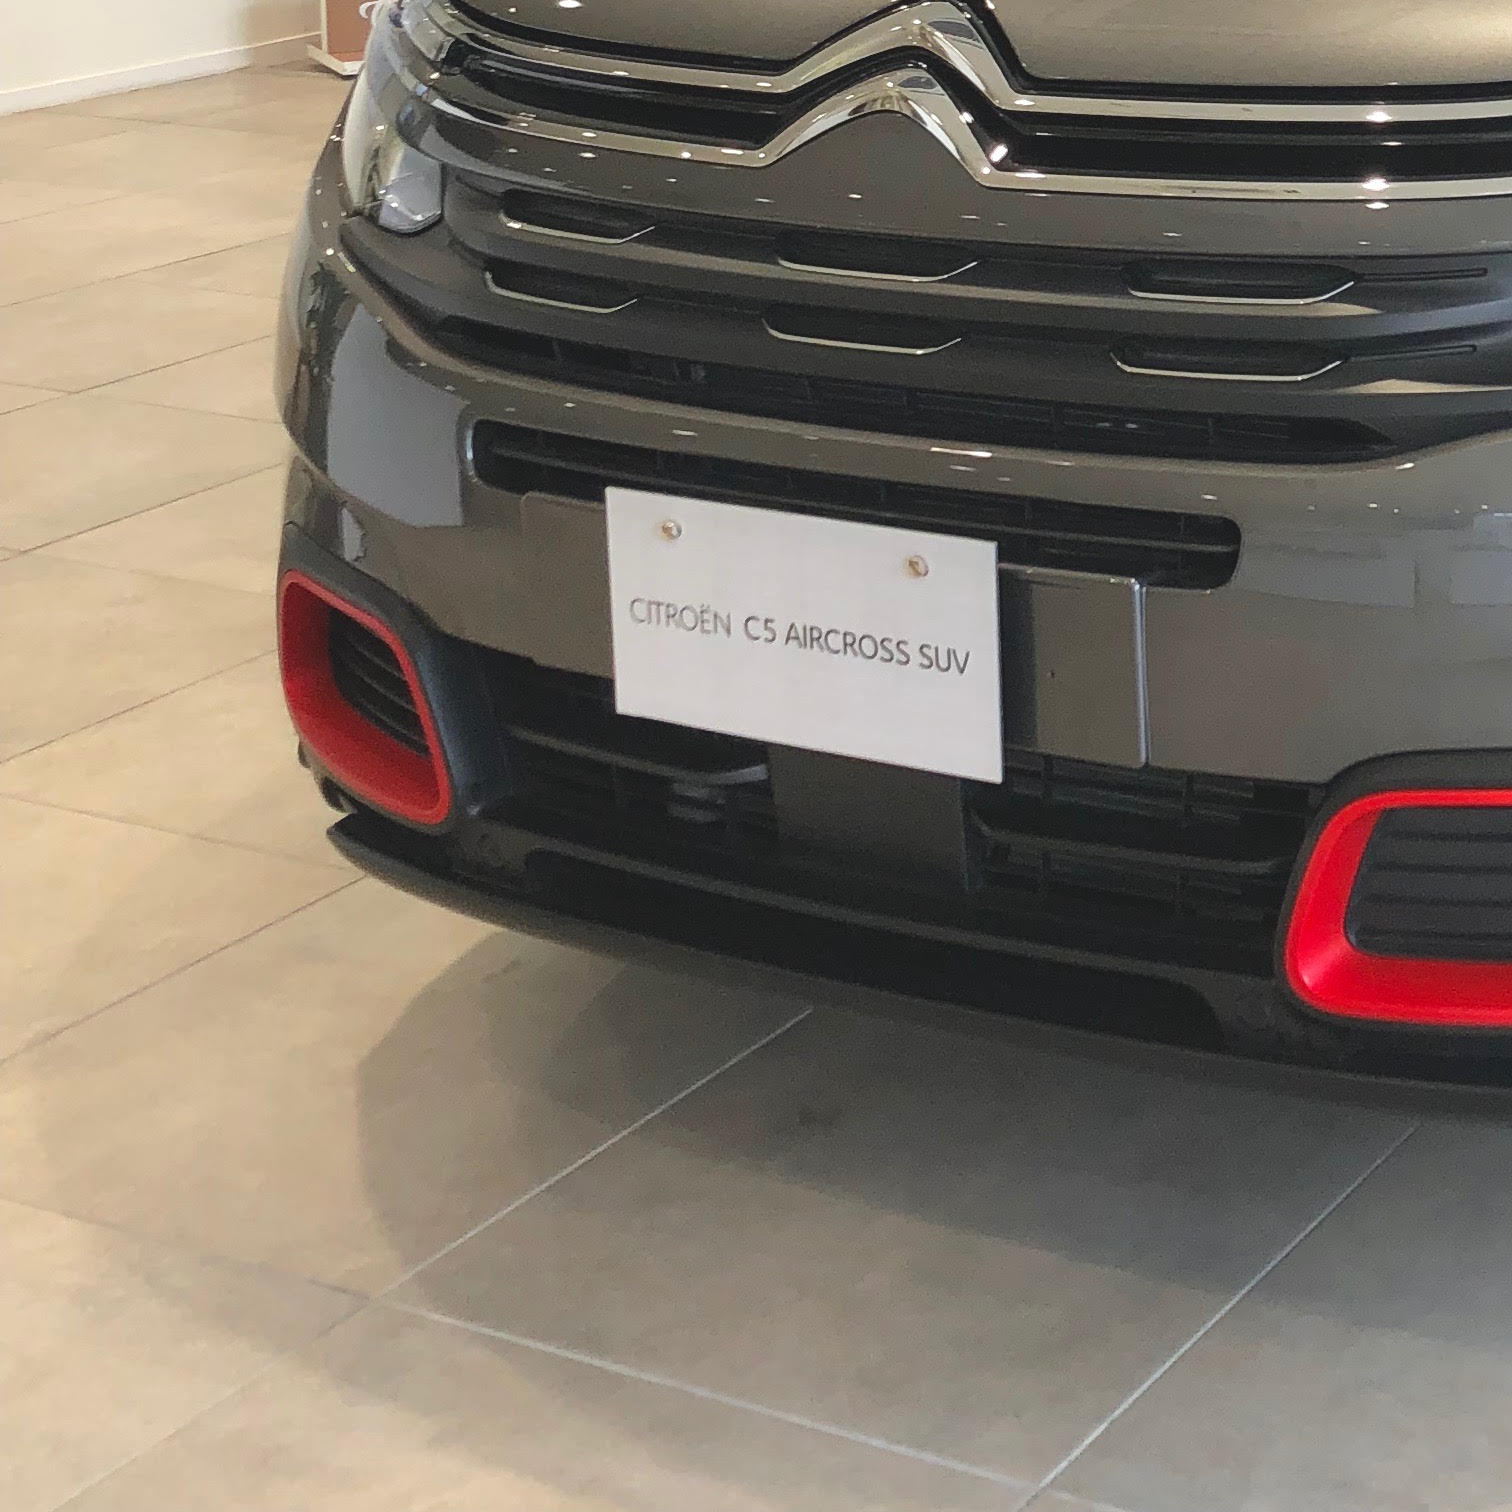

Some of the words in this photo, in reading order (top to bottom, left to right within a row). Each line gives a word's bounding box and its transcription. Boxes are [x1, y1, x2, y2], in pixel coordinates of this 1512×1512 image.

[629, 597, 732, 638] CITROËN
[744, 614, 777, 644] C5
[785, 622, 911, 667] AIRCROSS
[919, 643, 970, 675] SUV
